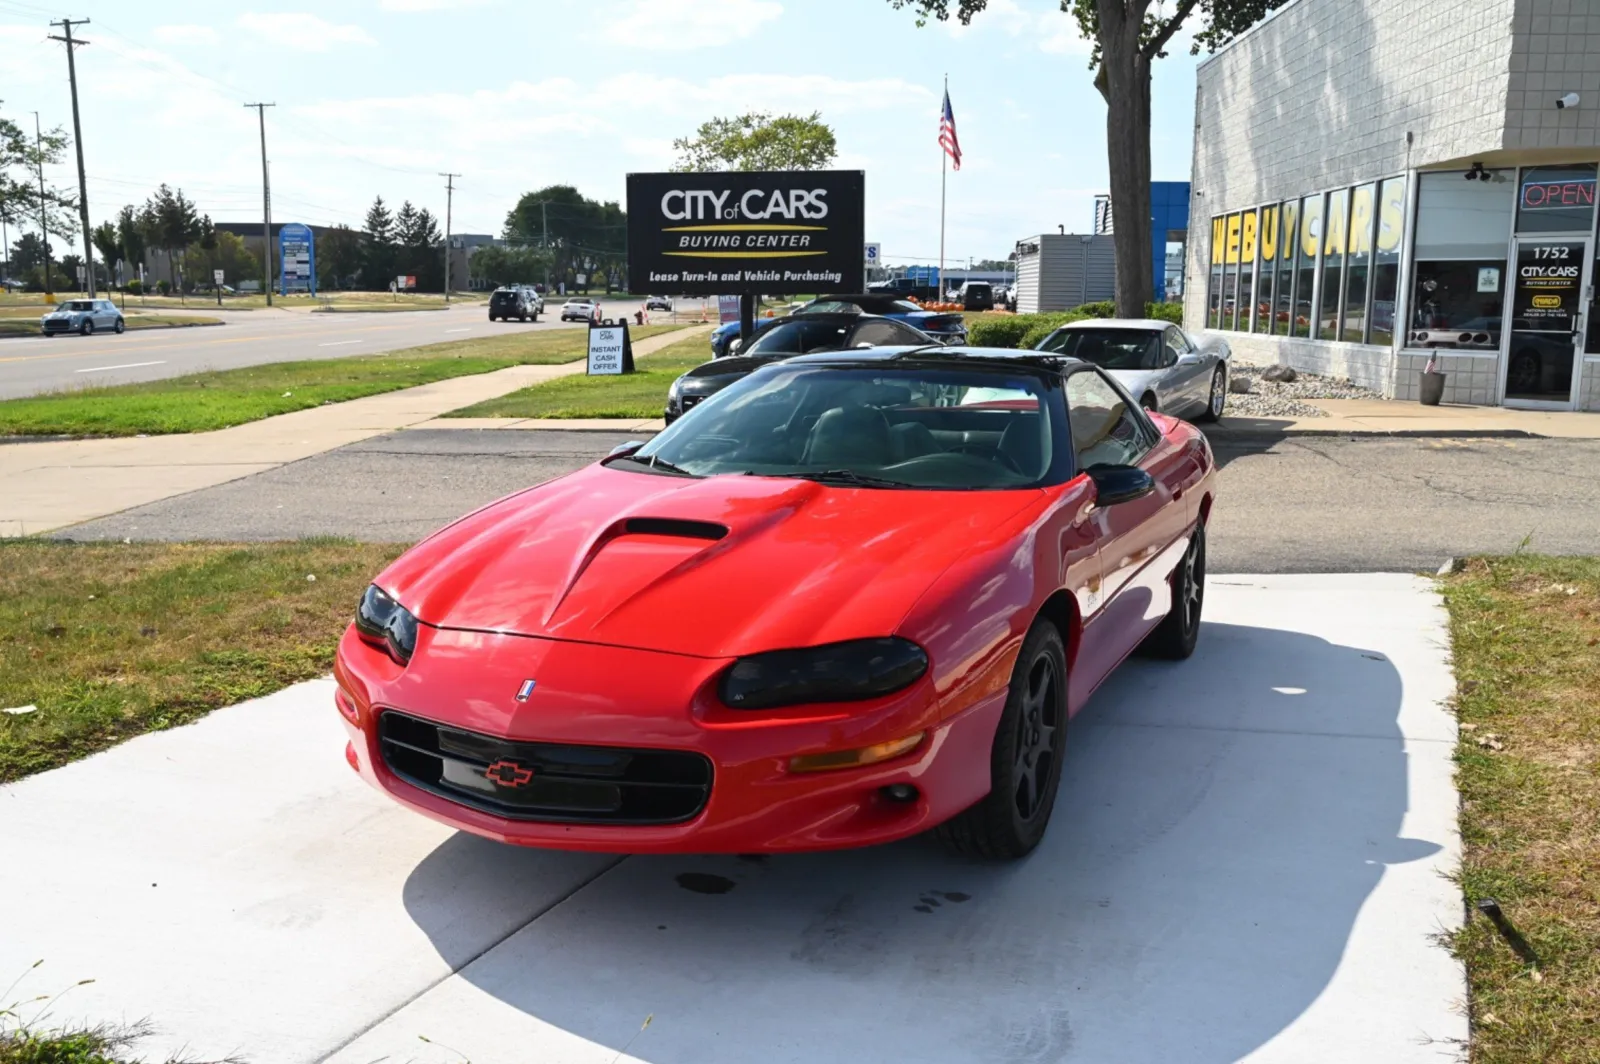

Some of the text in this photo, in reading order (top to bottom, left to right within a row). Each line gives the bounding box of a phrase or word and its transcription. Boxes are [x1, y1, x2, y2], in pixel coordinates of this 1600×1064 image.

[1525, 184, 1594, 205] OPEN
[661, 188, 828, 220] CITY of CARS
[1301, 181, 1405, 258] CARS
[679, 235, 811, 248] BUYING CENTER
[1533, 246, 1569, 259] 1752
[649, 270, 842, 283] Lease Turn-In and Vehicle Purchasing
[1521, 266, 1546, 277] CITY
[1547, 266, 1578, 277] CARS
[591, 345, 622, 353] INSTANT
